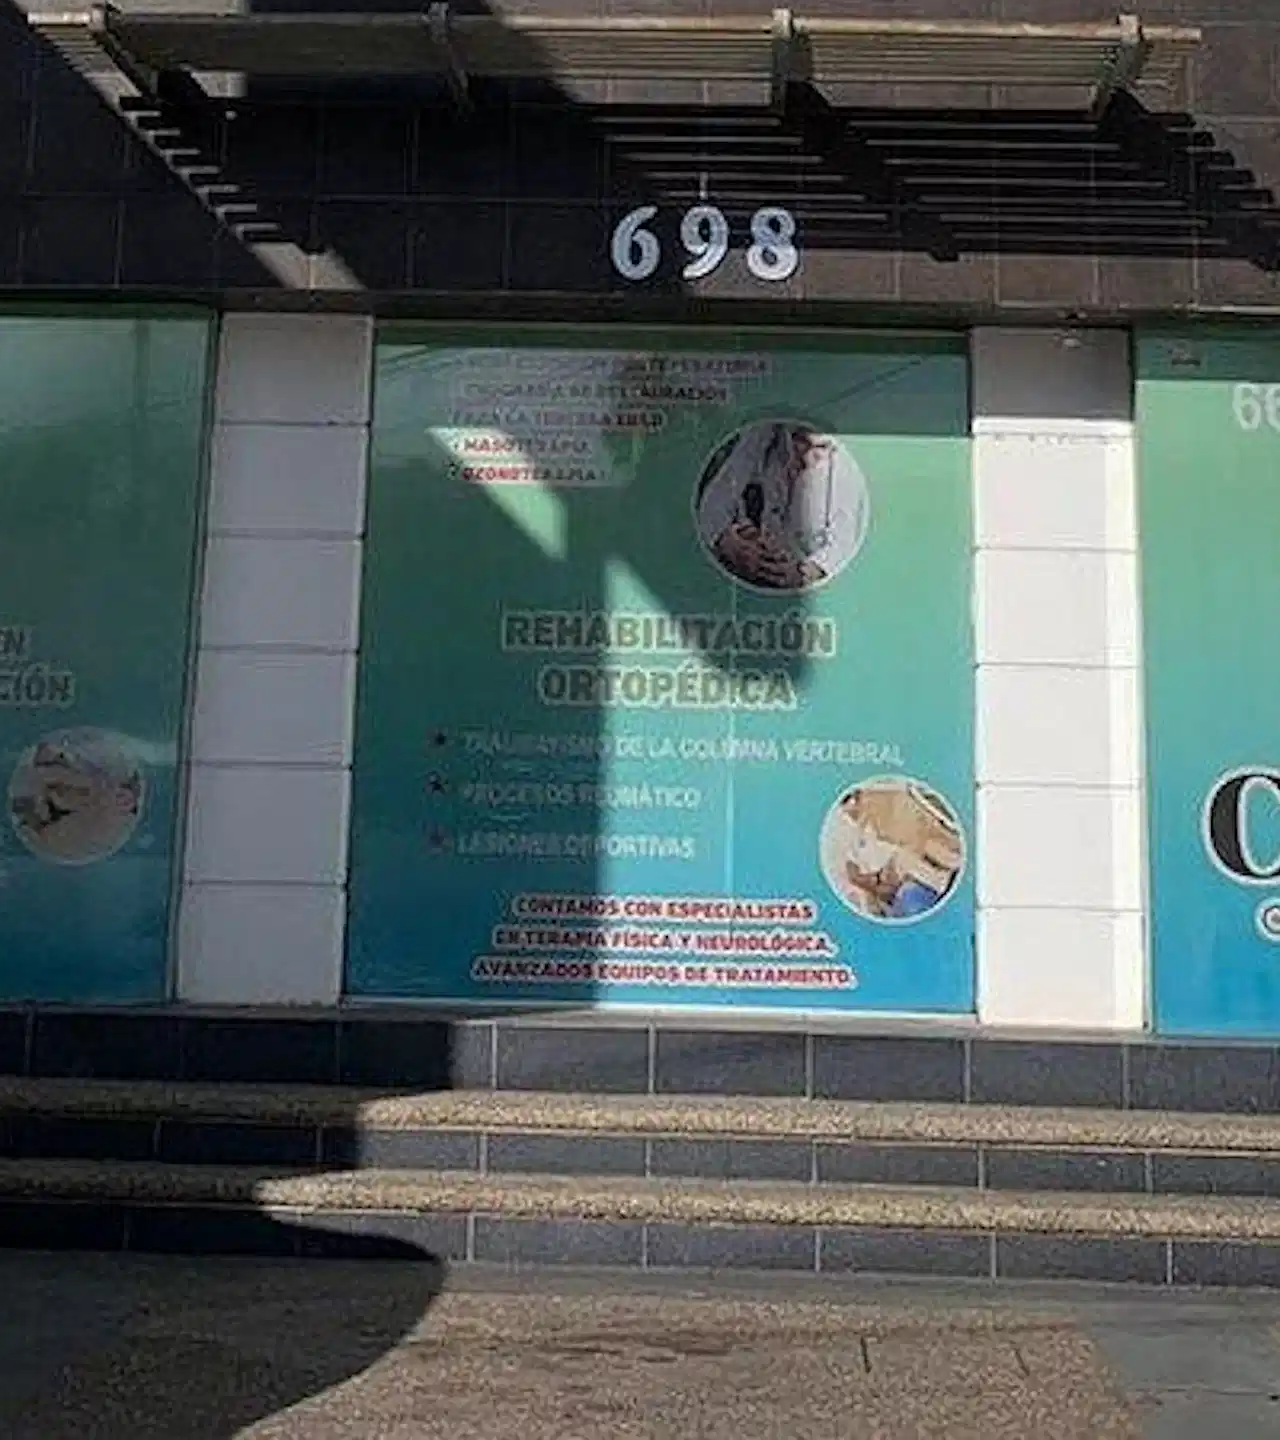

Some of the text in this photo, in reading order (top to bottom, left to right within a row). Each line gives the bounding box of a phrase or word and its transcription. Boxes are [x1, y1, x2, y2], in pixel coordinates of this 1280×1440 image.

[612, 205, 799, 281] 698
[505, 610, 833, 654] REHABILITACIÓN
[542, 660, 795, 704] ORTOPÉDICA
[616, 735, 642, 758] DE
[648, 736, 677, 759] LA
[784, 739, 905, 765] VERTEBRAL
[517, 899, 814, 920] CONTAMOS CON ESPECIALISTAS
[495, 931, 521, 946] EN
[524, 931, 607, 949] TERAPIA
[611, 928, 673, 950] FÍSICA
[681, 933, 691, 950] Y
[475, 962, 593, 979] AVANZADOS
[598, 965, 681, 981] EQUIPOS
[685, 966, 709, 981] DE
